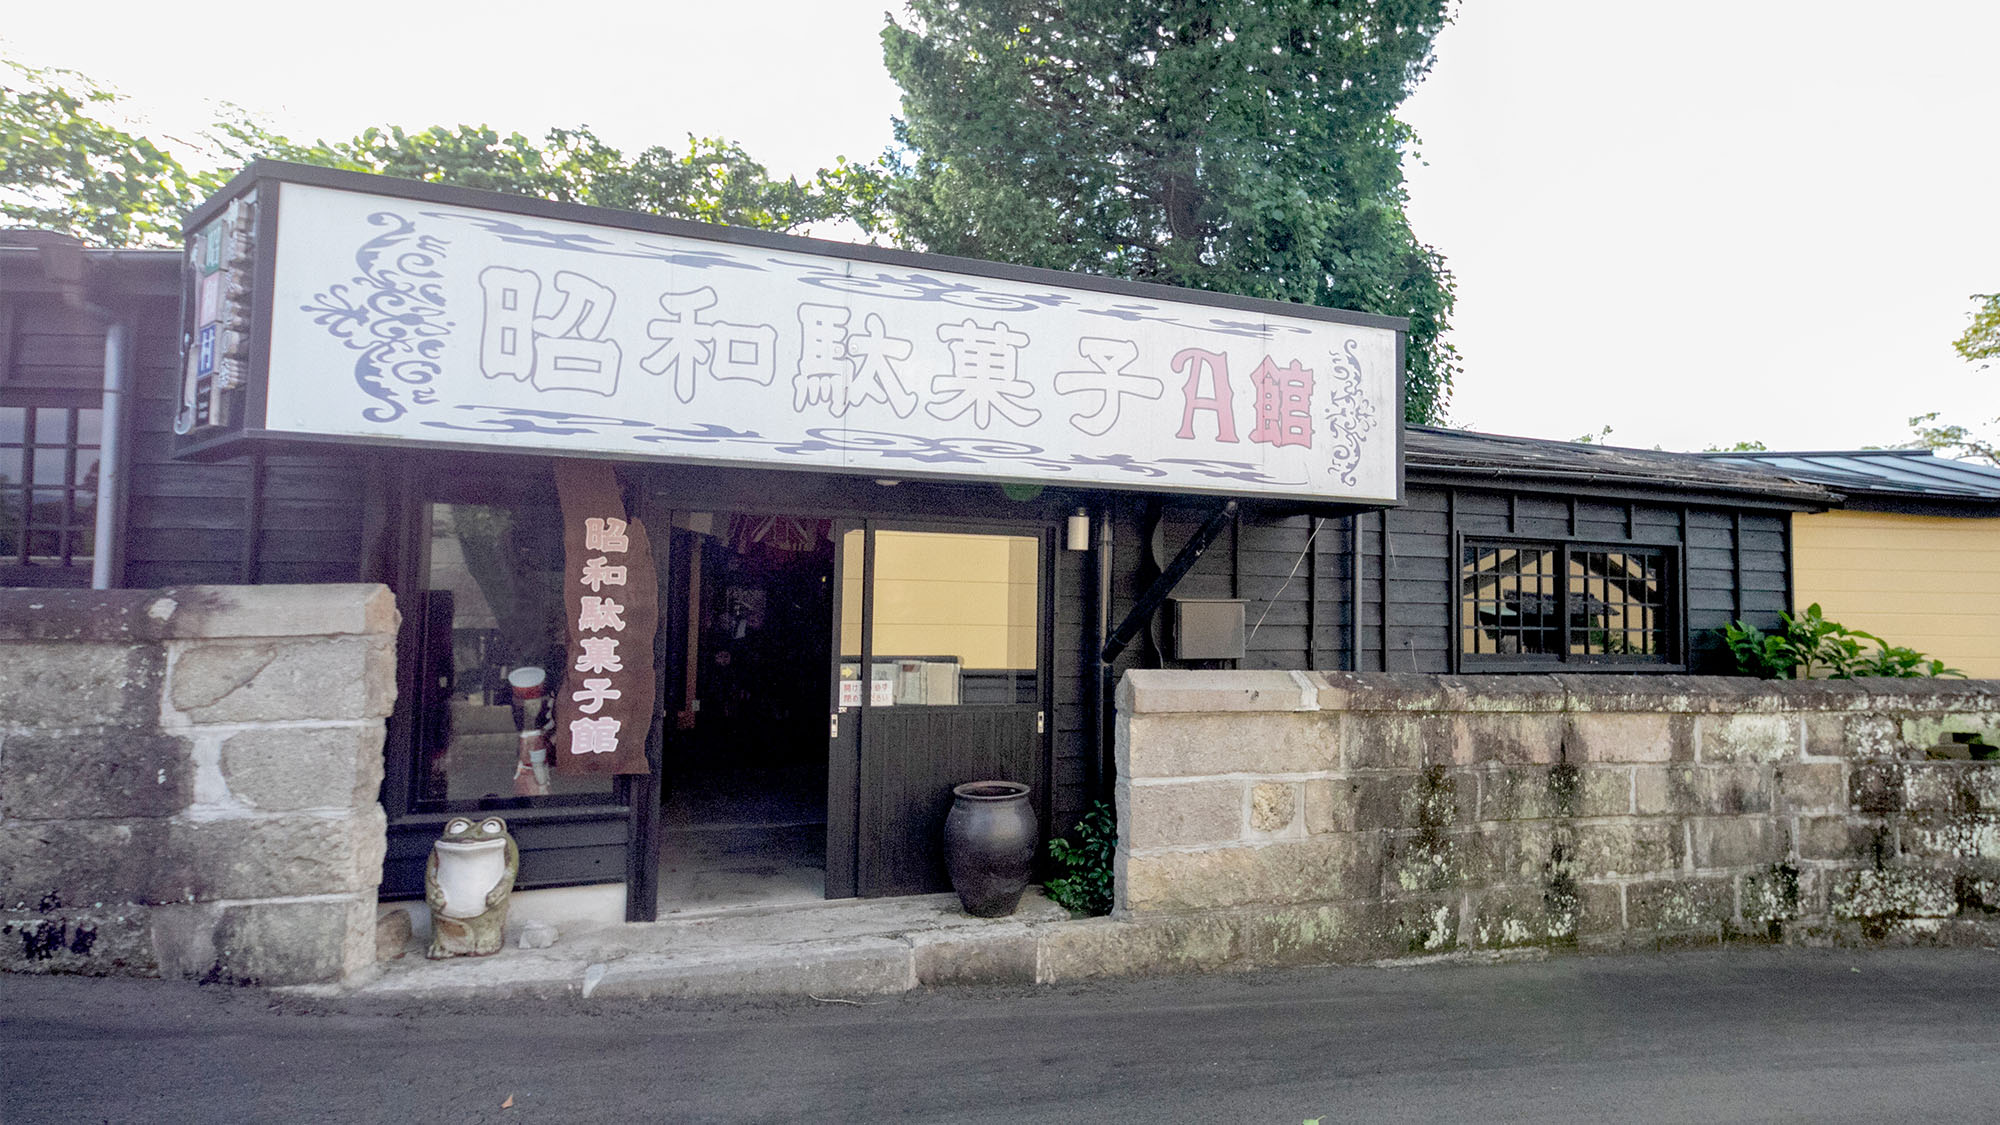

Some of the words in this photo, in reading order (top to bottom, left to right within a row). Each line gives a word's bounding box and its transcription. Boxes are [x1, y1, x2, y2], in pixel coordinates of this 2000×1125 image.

[570, 517, 629, 755] 昭和駄菓子館
